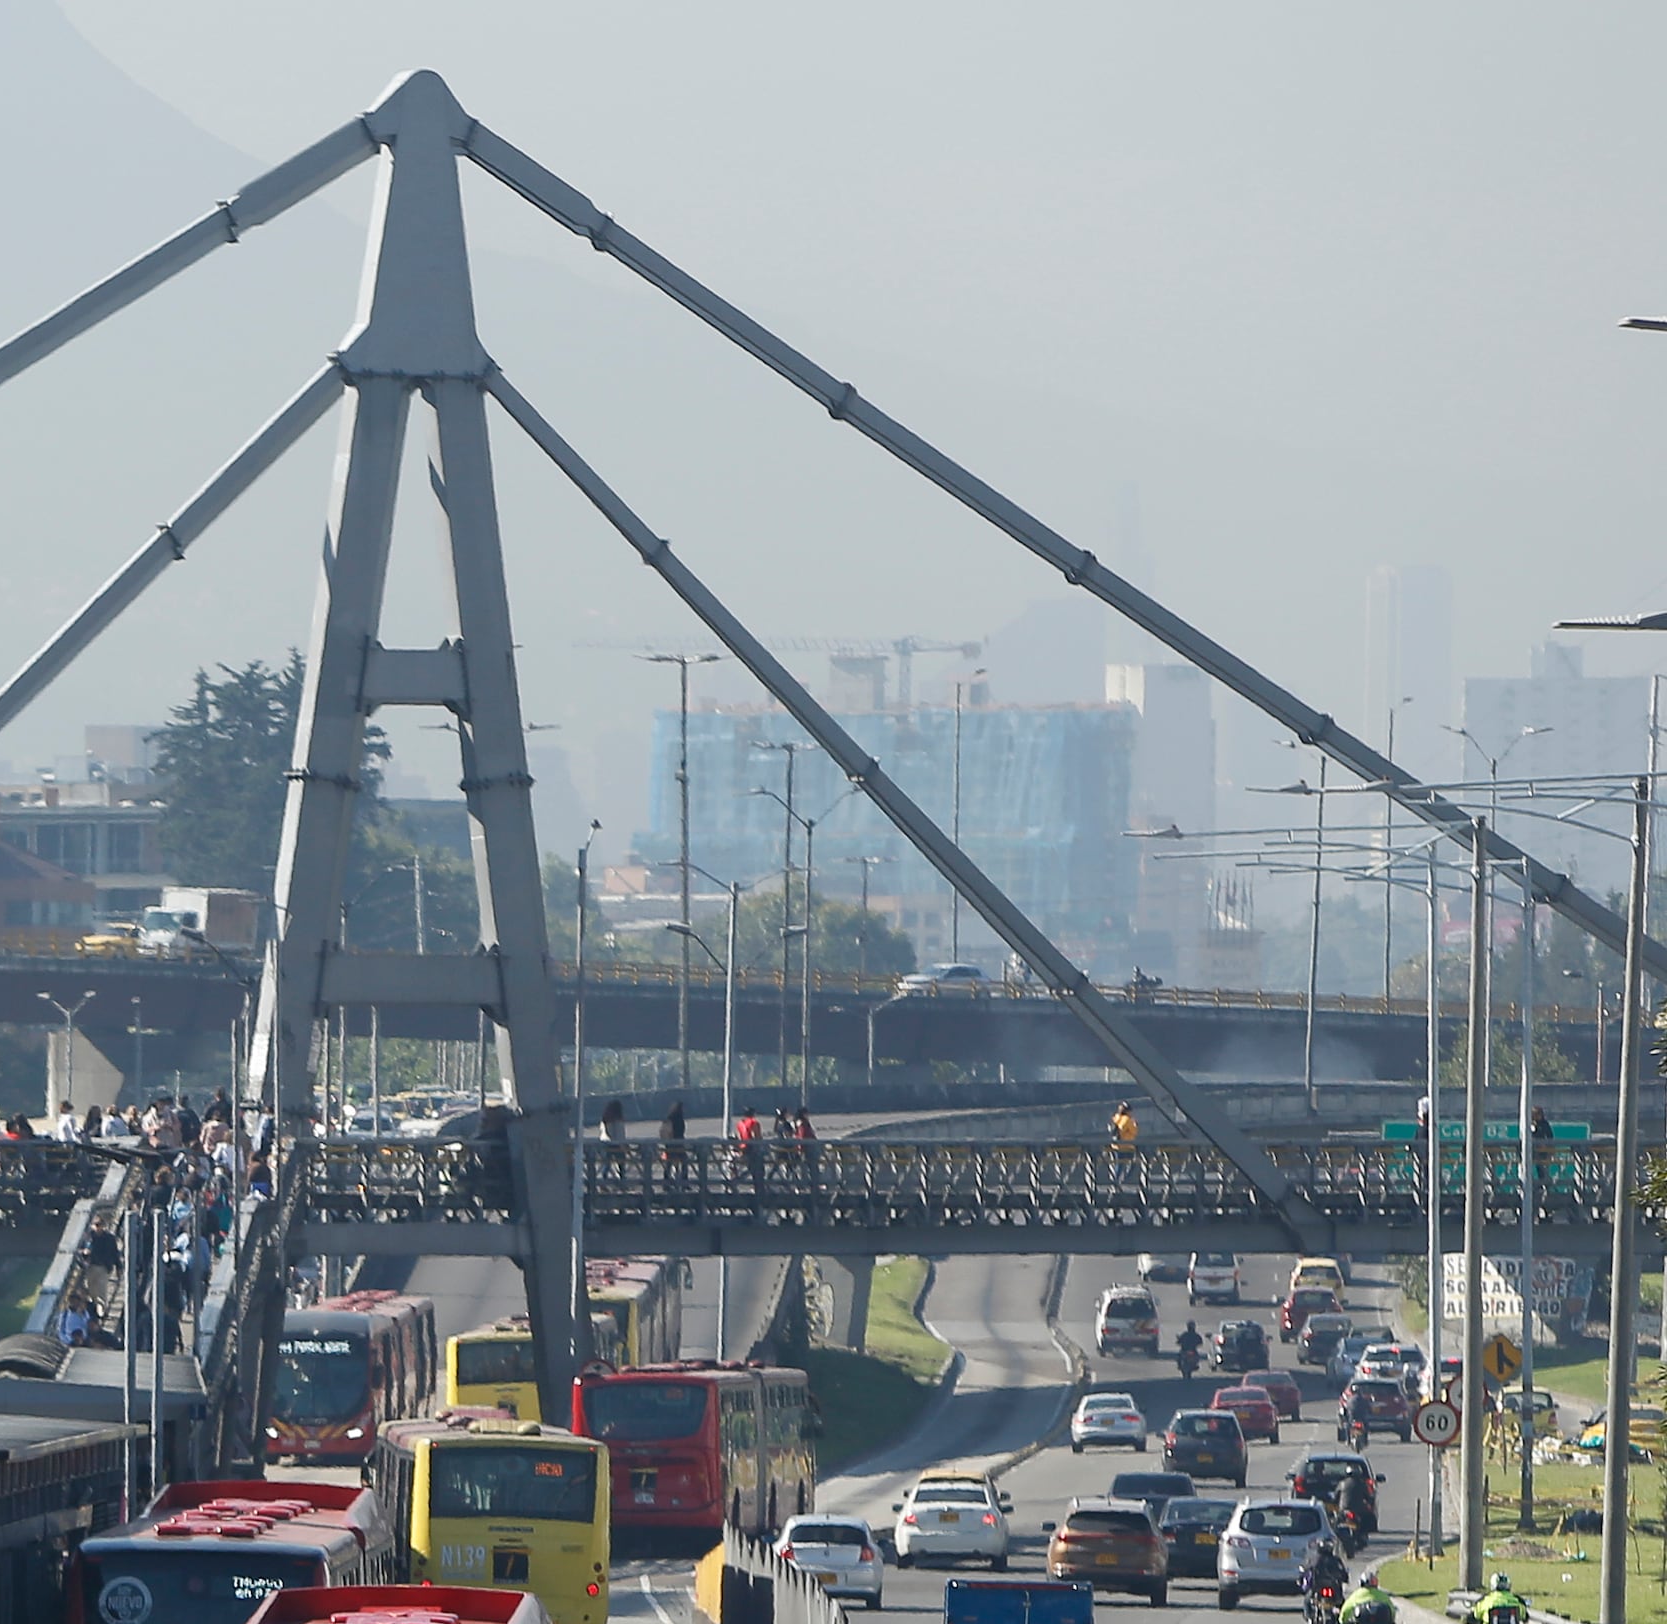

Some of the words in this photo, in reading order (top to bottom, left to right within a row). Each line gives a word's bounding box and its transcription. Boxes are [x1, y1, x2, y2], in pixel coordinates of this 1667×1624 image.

[1487, 1125, 1508, 1138] 82
[1426, 1414, 1448, 1431] 60
[441, 1545, 487, 1568] N139
[107, 1595, 143, 1609] NUEVO
